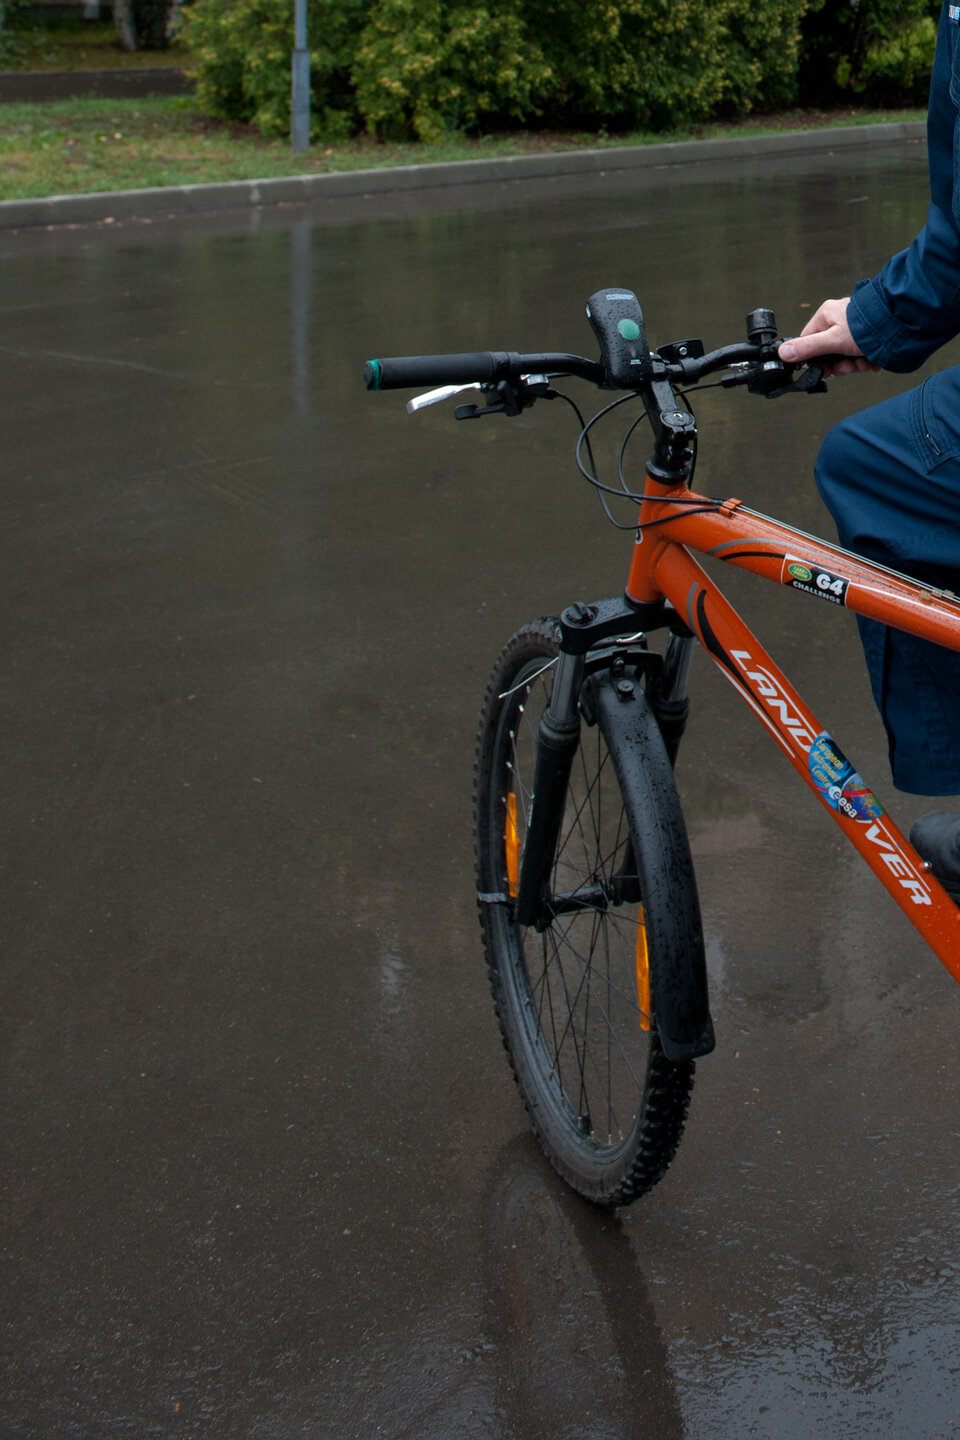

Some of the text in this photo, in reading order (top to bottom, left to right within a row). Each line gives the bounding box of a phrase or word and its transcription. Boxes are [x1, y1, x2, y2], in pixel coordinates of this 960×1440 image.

[792, 580, 841, 605] CHALLENGE
[816, 573, 844, 596] G4
[729, 649, 813, 752] LAND
[811, 750, 842, 782] Astronaut
[815, 738, 844, 770] European
[812, 765, 832, 788] Centre
[838, 797, 858, 819] esa
